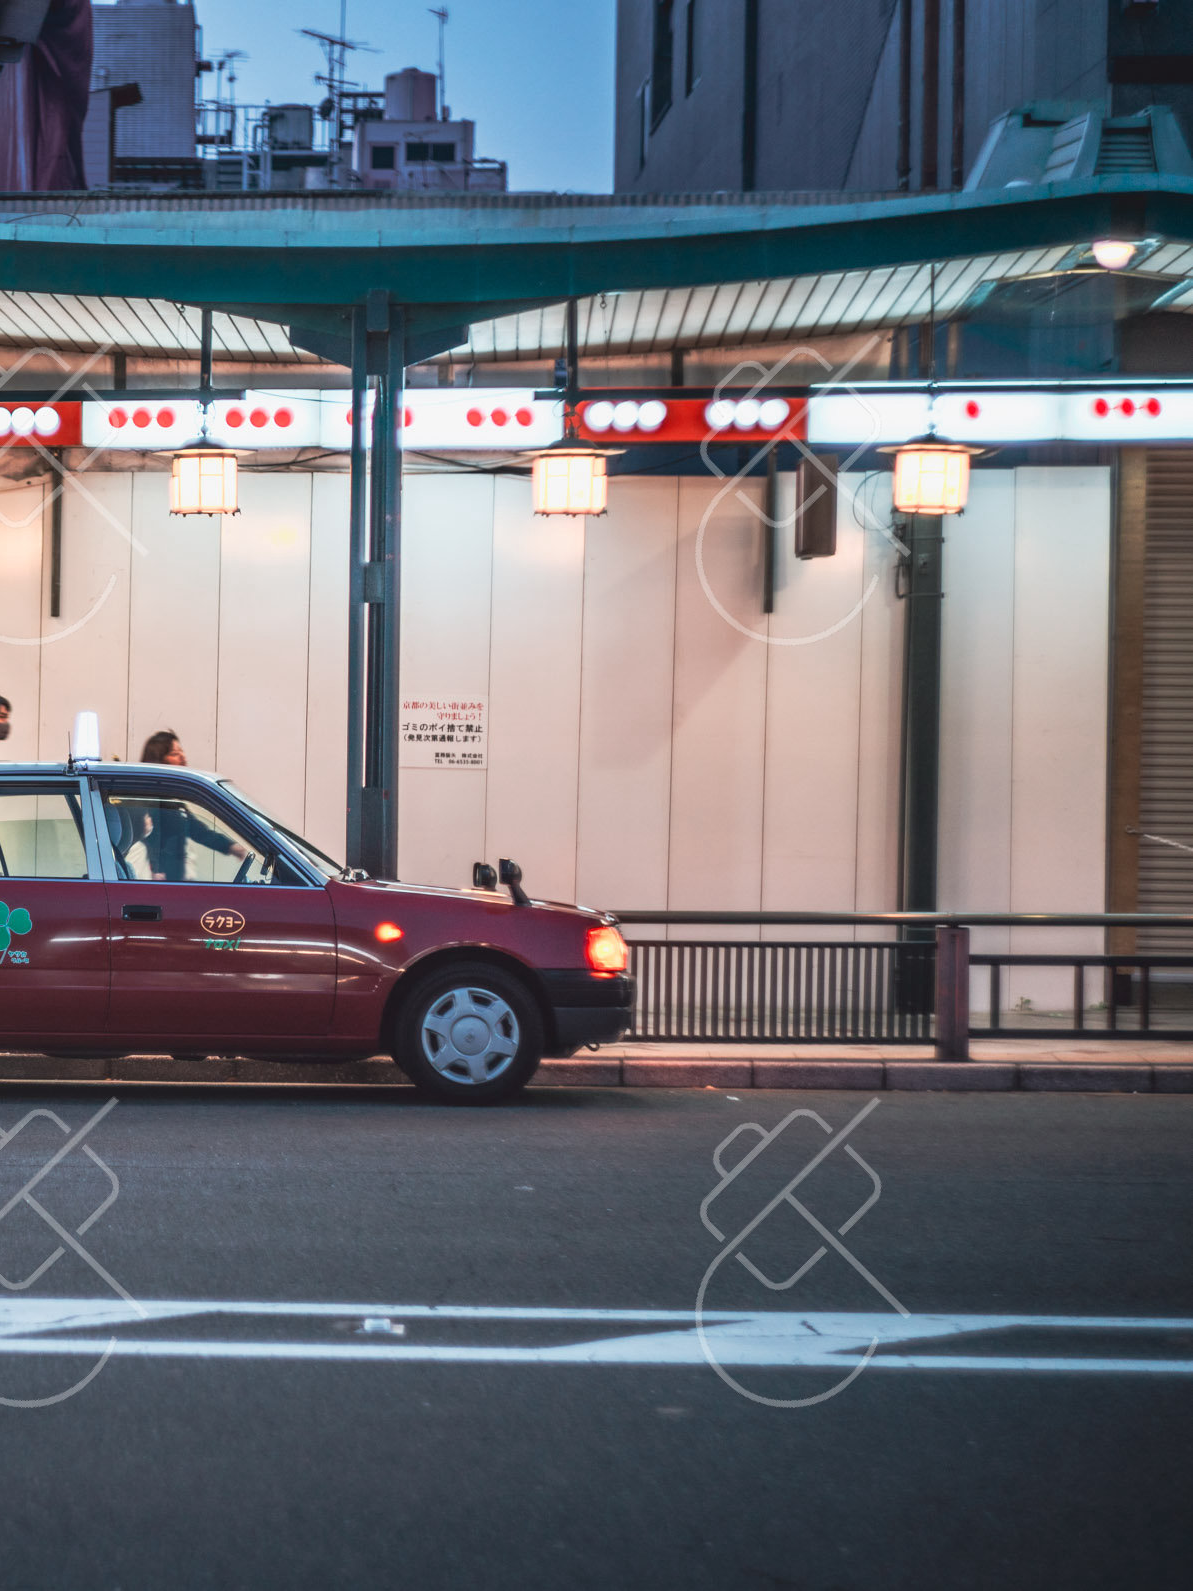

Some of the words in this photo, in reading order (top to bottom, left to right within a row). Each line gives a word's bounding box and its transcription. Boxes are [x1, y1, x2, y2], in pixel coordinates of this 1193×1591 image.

[403, 701, 484, 711] 京都の美しい街並みを
[402, 722, 484, 733] ゴミのポイ捨て禁止
[205, 915, 242, 929] ラクヨー
